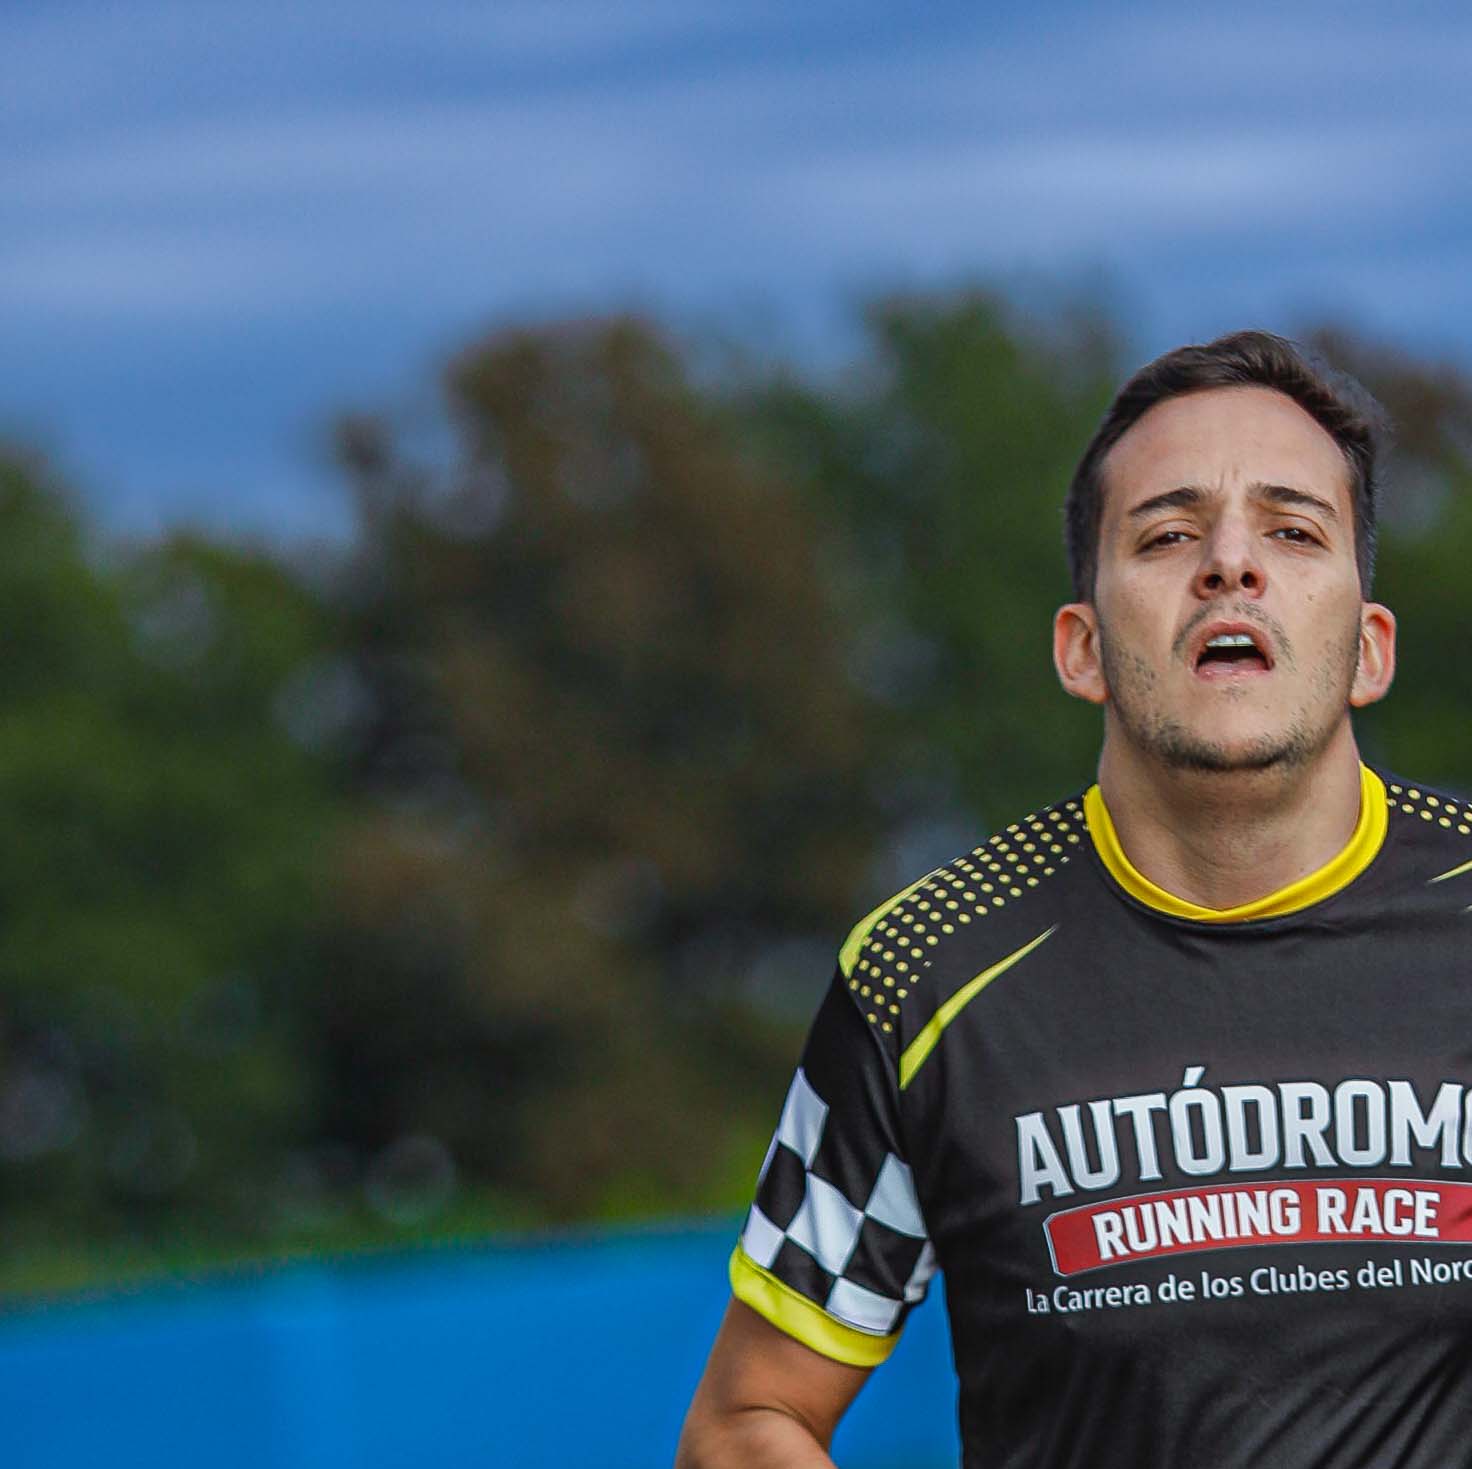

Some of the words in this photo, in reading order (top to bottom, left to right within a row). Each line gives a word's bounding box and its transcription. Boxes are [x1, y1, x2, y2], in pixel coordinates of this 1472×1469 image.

[1091, 1189, 1300, 1261] RUNNING
[1316, 1187, 1441, 1237] RACE
[1026, 1288, 1050, 1314] La
[1053, 1283, 1148, 1313] Carrera
[1158, 1274, 1195, 1302] de
[1202, 1270, 1242, 1299] los
[1250, 1262, 1350, 1295] Clubes
[1357, 1256, 1403, 1287] del
